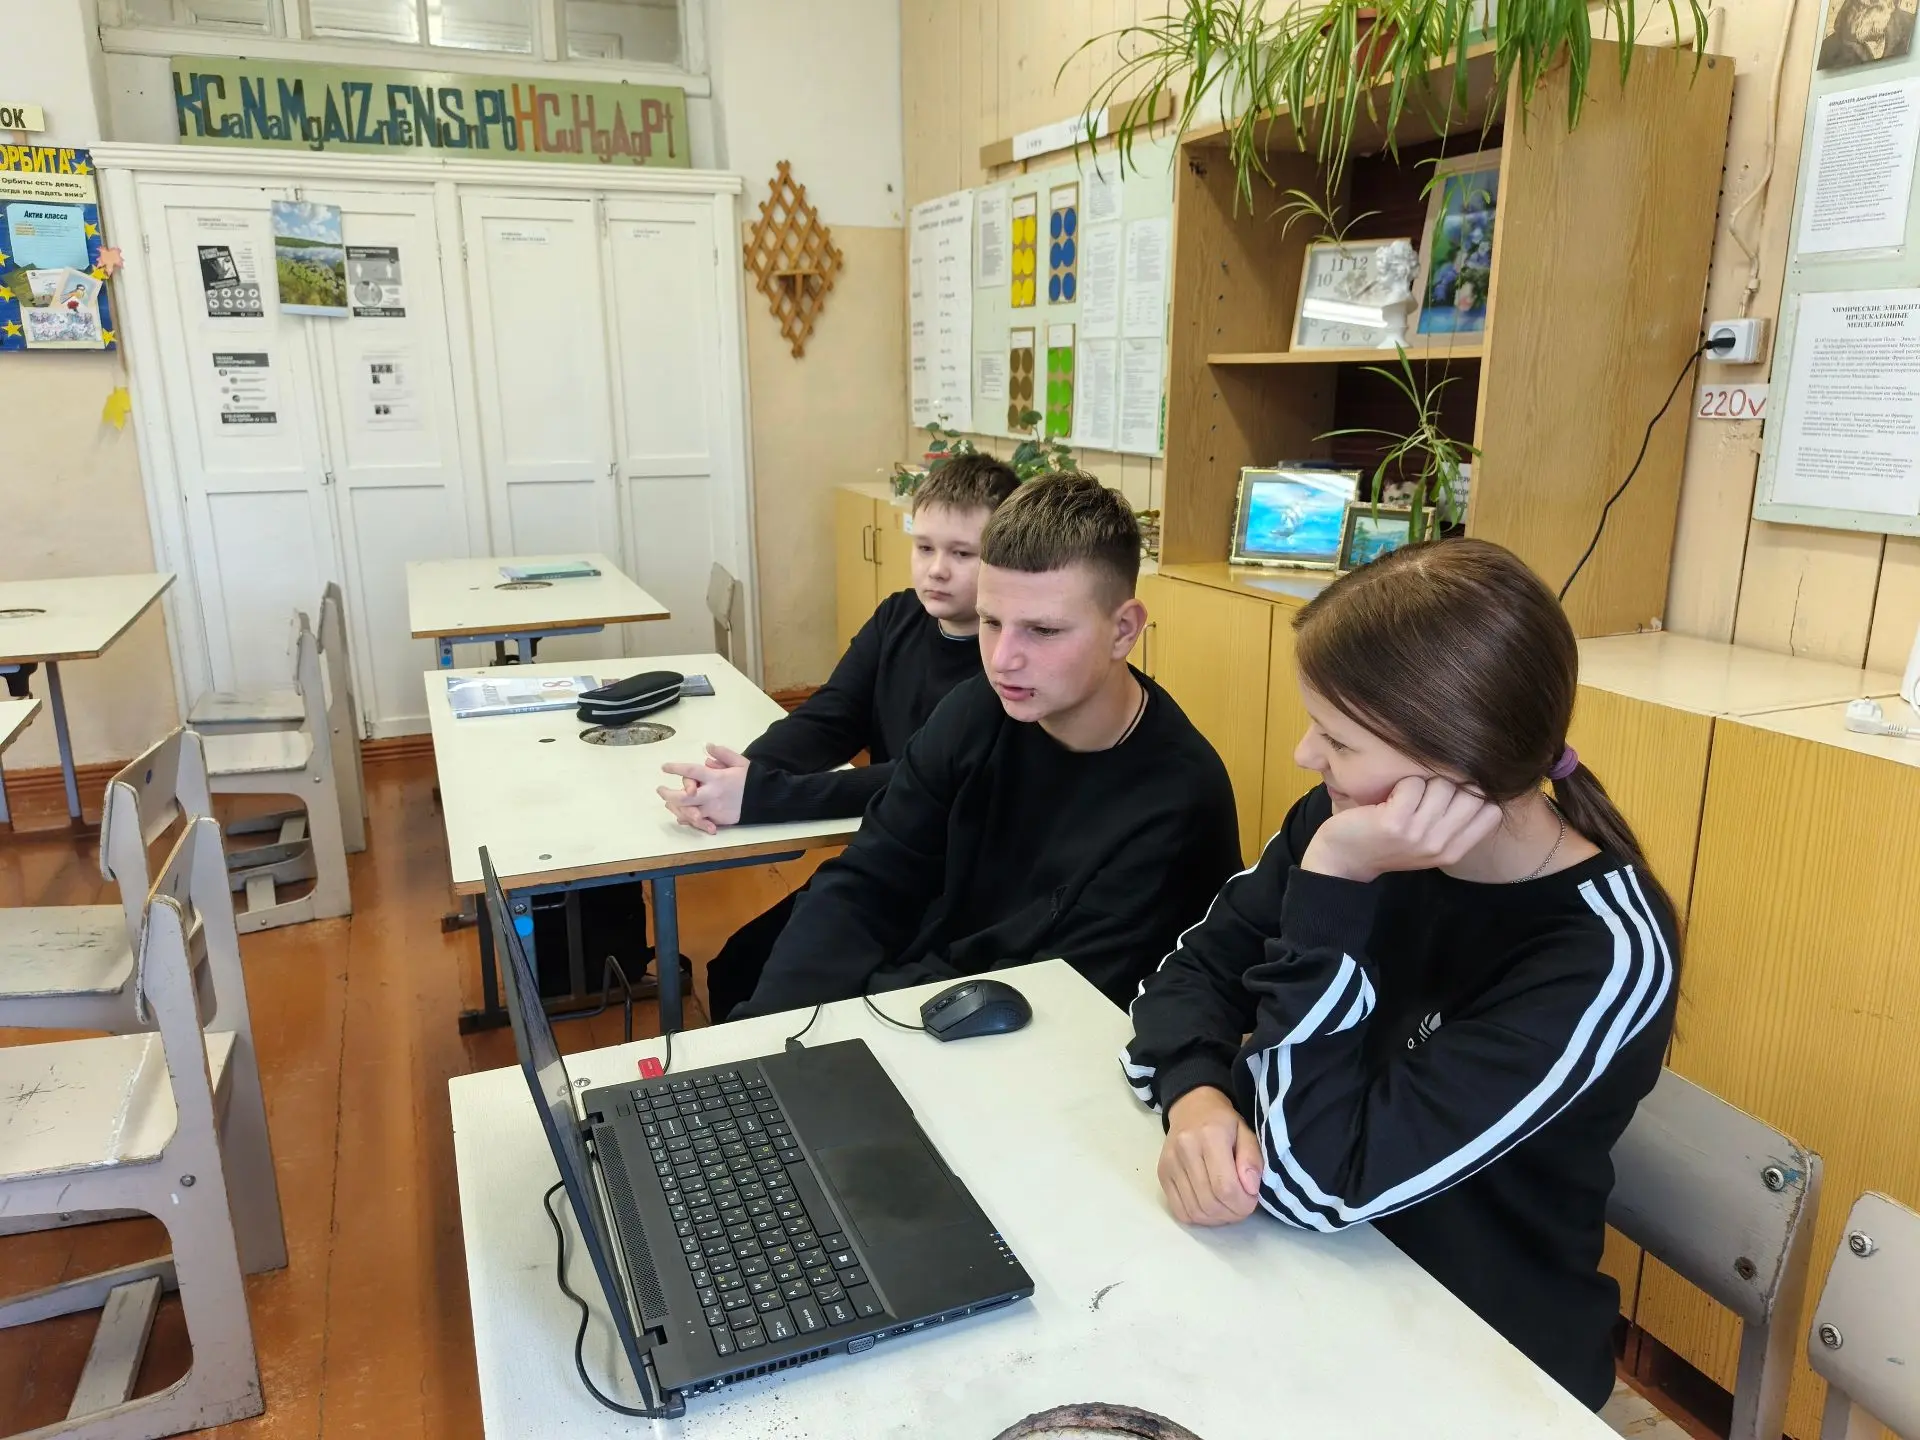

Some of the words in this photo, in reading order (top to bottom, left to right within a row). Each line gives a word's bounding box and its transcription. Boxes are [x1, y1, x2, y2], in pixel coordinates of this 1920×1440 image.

[1, 177, 33, 185] Орбиты
[24, 210, 43, 219] Актив
[44, 212, 68, 220] класса
